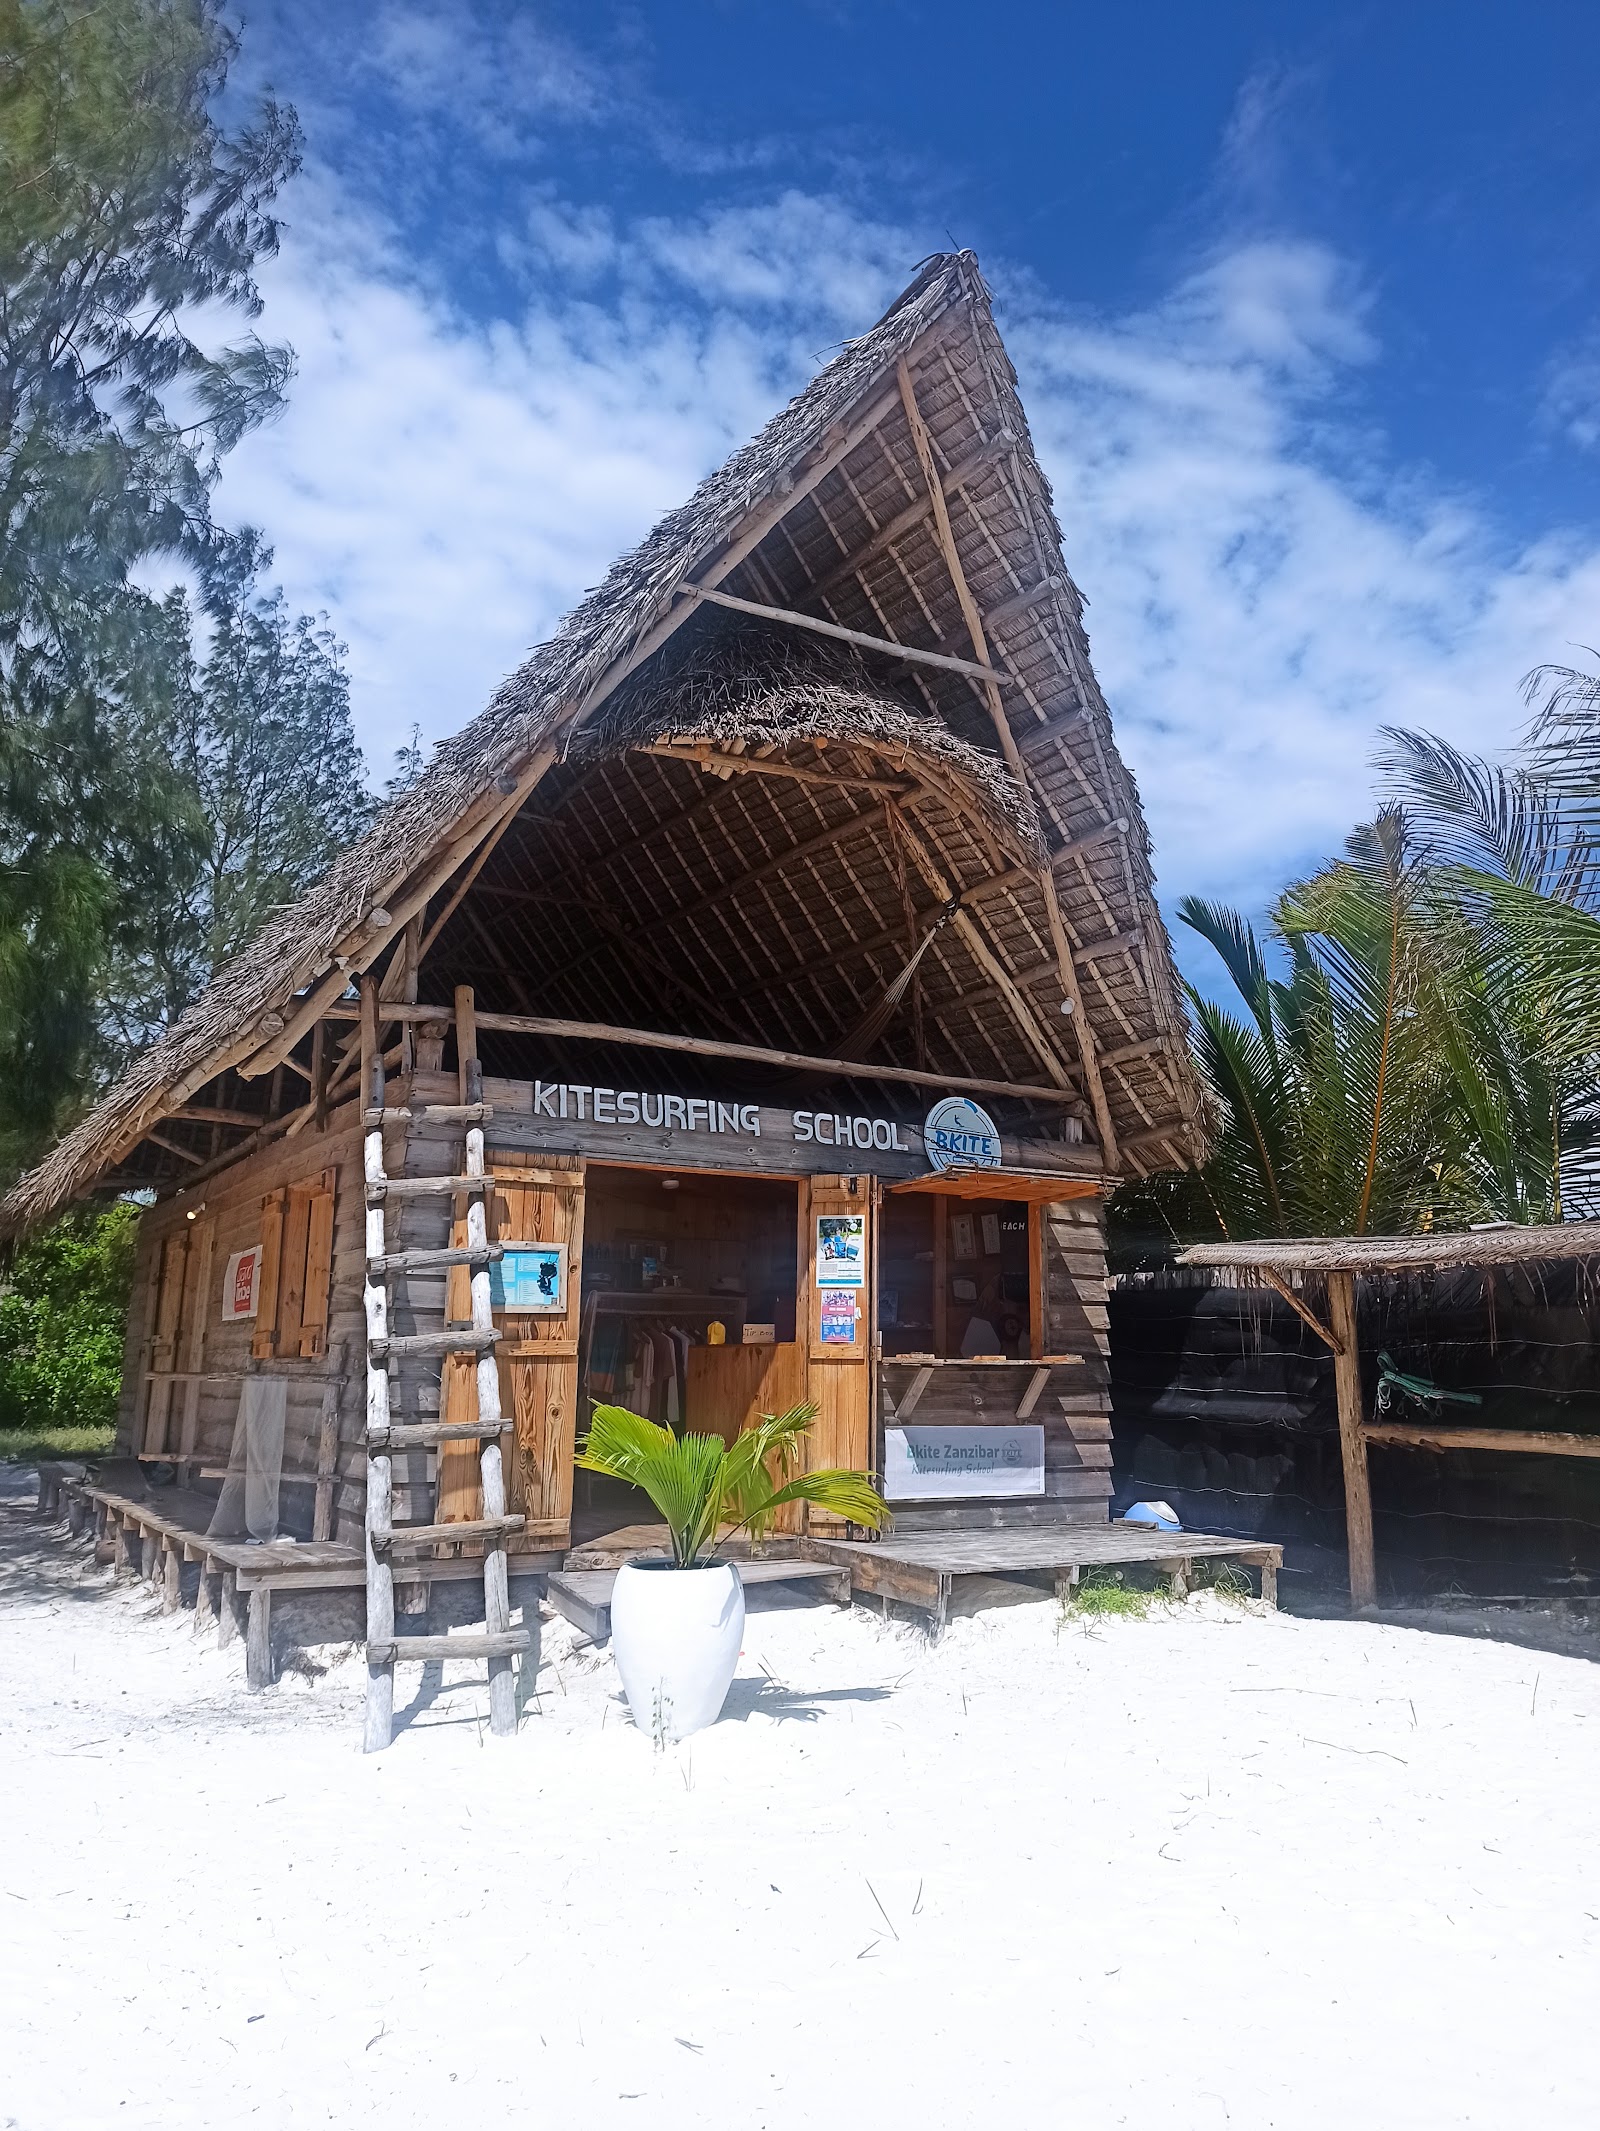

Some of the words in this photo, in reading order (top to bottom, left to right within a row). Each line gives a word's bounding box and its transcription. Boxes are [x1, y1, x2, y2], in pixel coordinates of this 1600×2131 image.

[533, 1080, 760, 1136] KITESURFING
[792, 1111, 909, 1151] SCHOOL
[935, 1130, 992, 1155] BKITE
[1001, 1222, 1025, 1231] EACH
[907, 1444, 940, 1458] Bkite
[943, 1444, 999, 1458] Zanzibar
[911, 1461, 962, 1477] Kitesurfing
[965, 1462, 995, 1475] School
